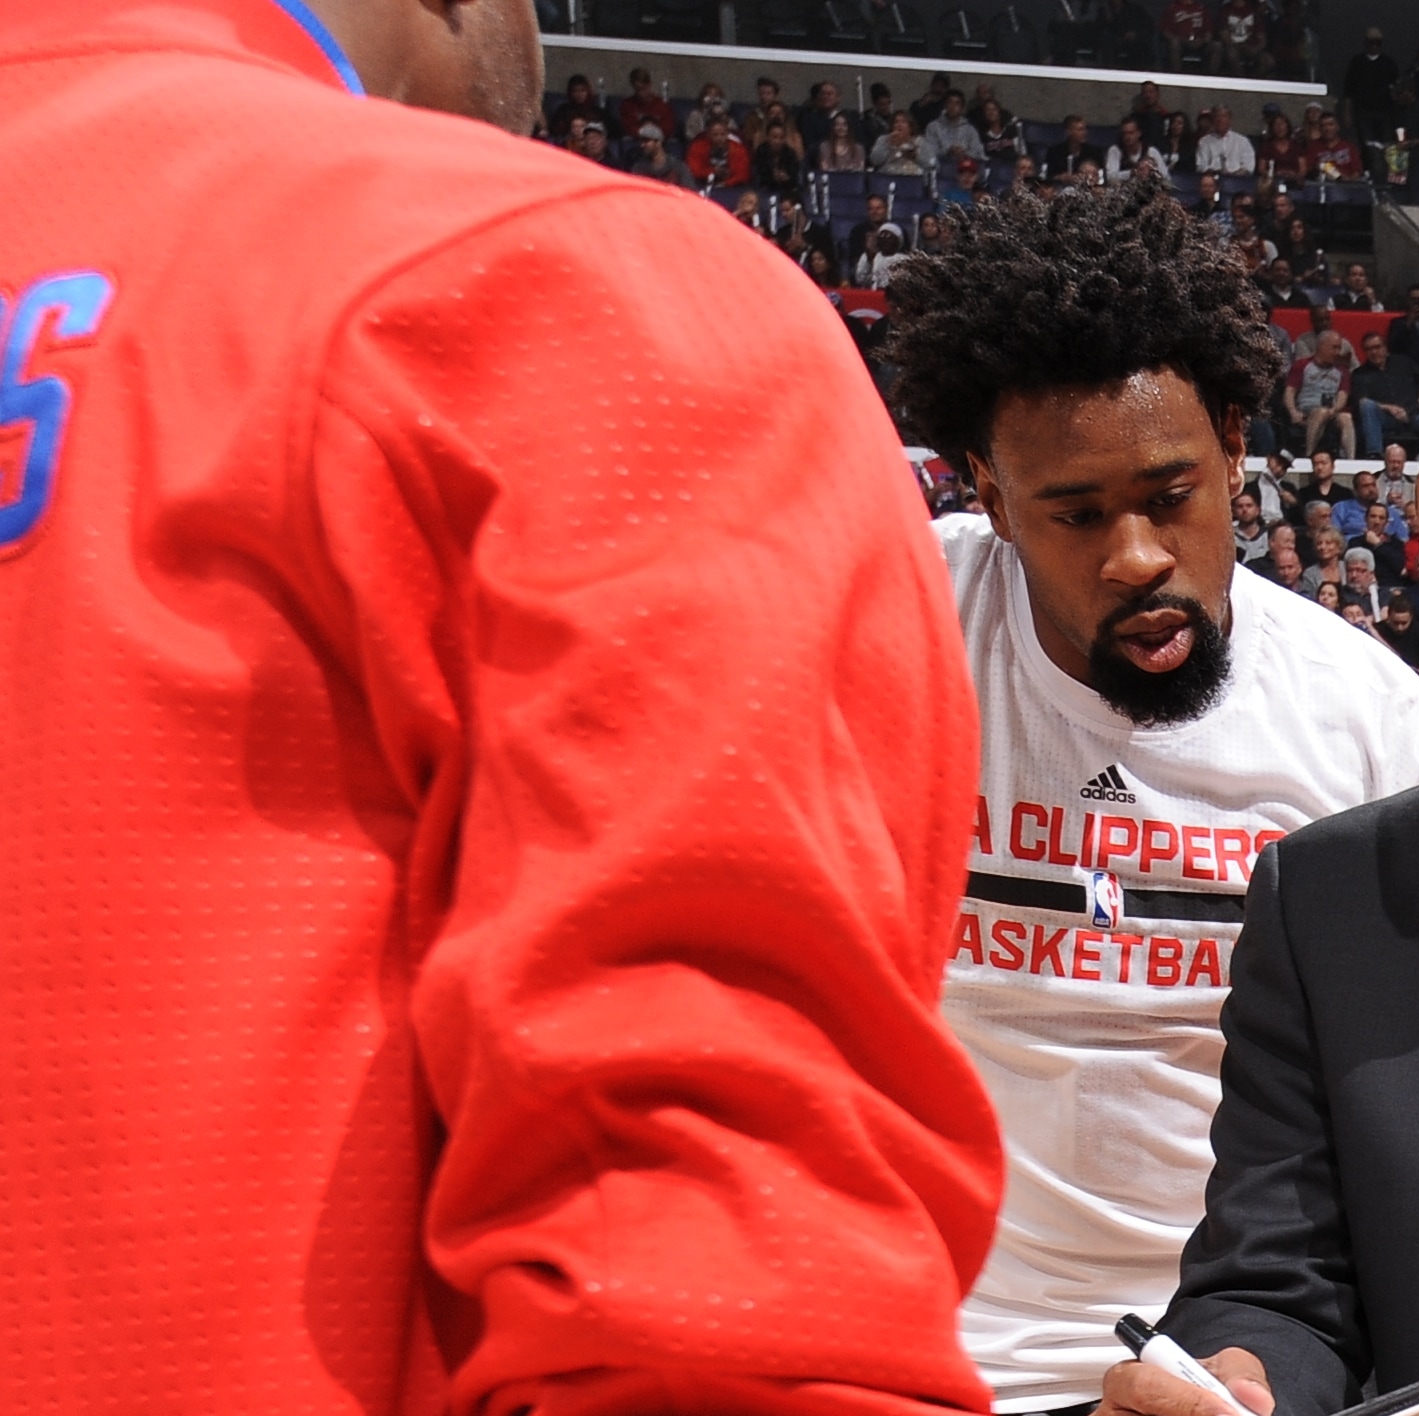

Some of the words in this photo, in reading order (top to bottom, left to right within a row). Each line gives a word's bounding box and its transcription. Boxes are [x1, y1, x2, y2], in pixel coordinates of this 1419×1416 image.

[972, 794, 994, 856] A
[1080, 786, 1137, 804] adidas
[948, 912, 1232, 988] ASKETBA
